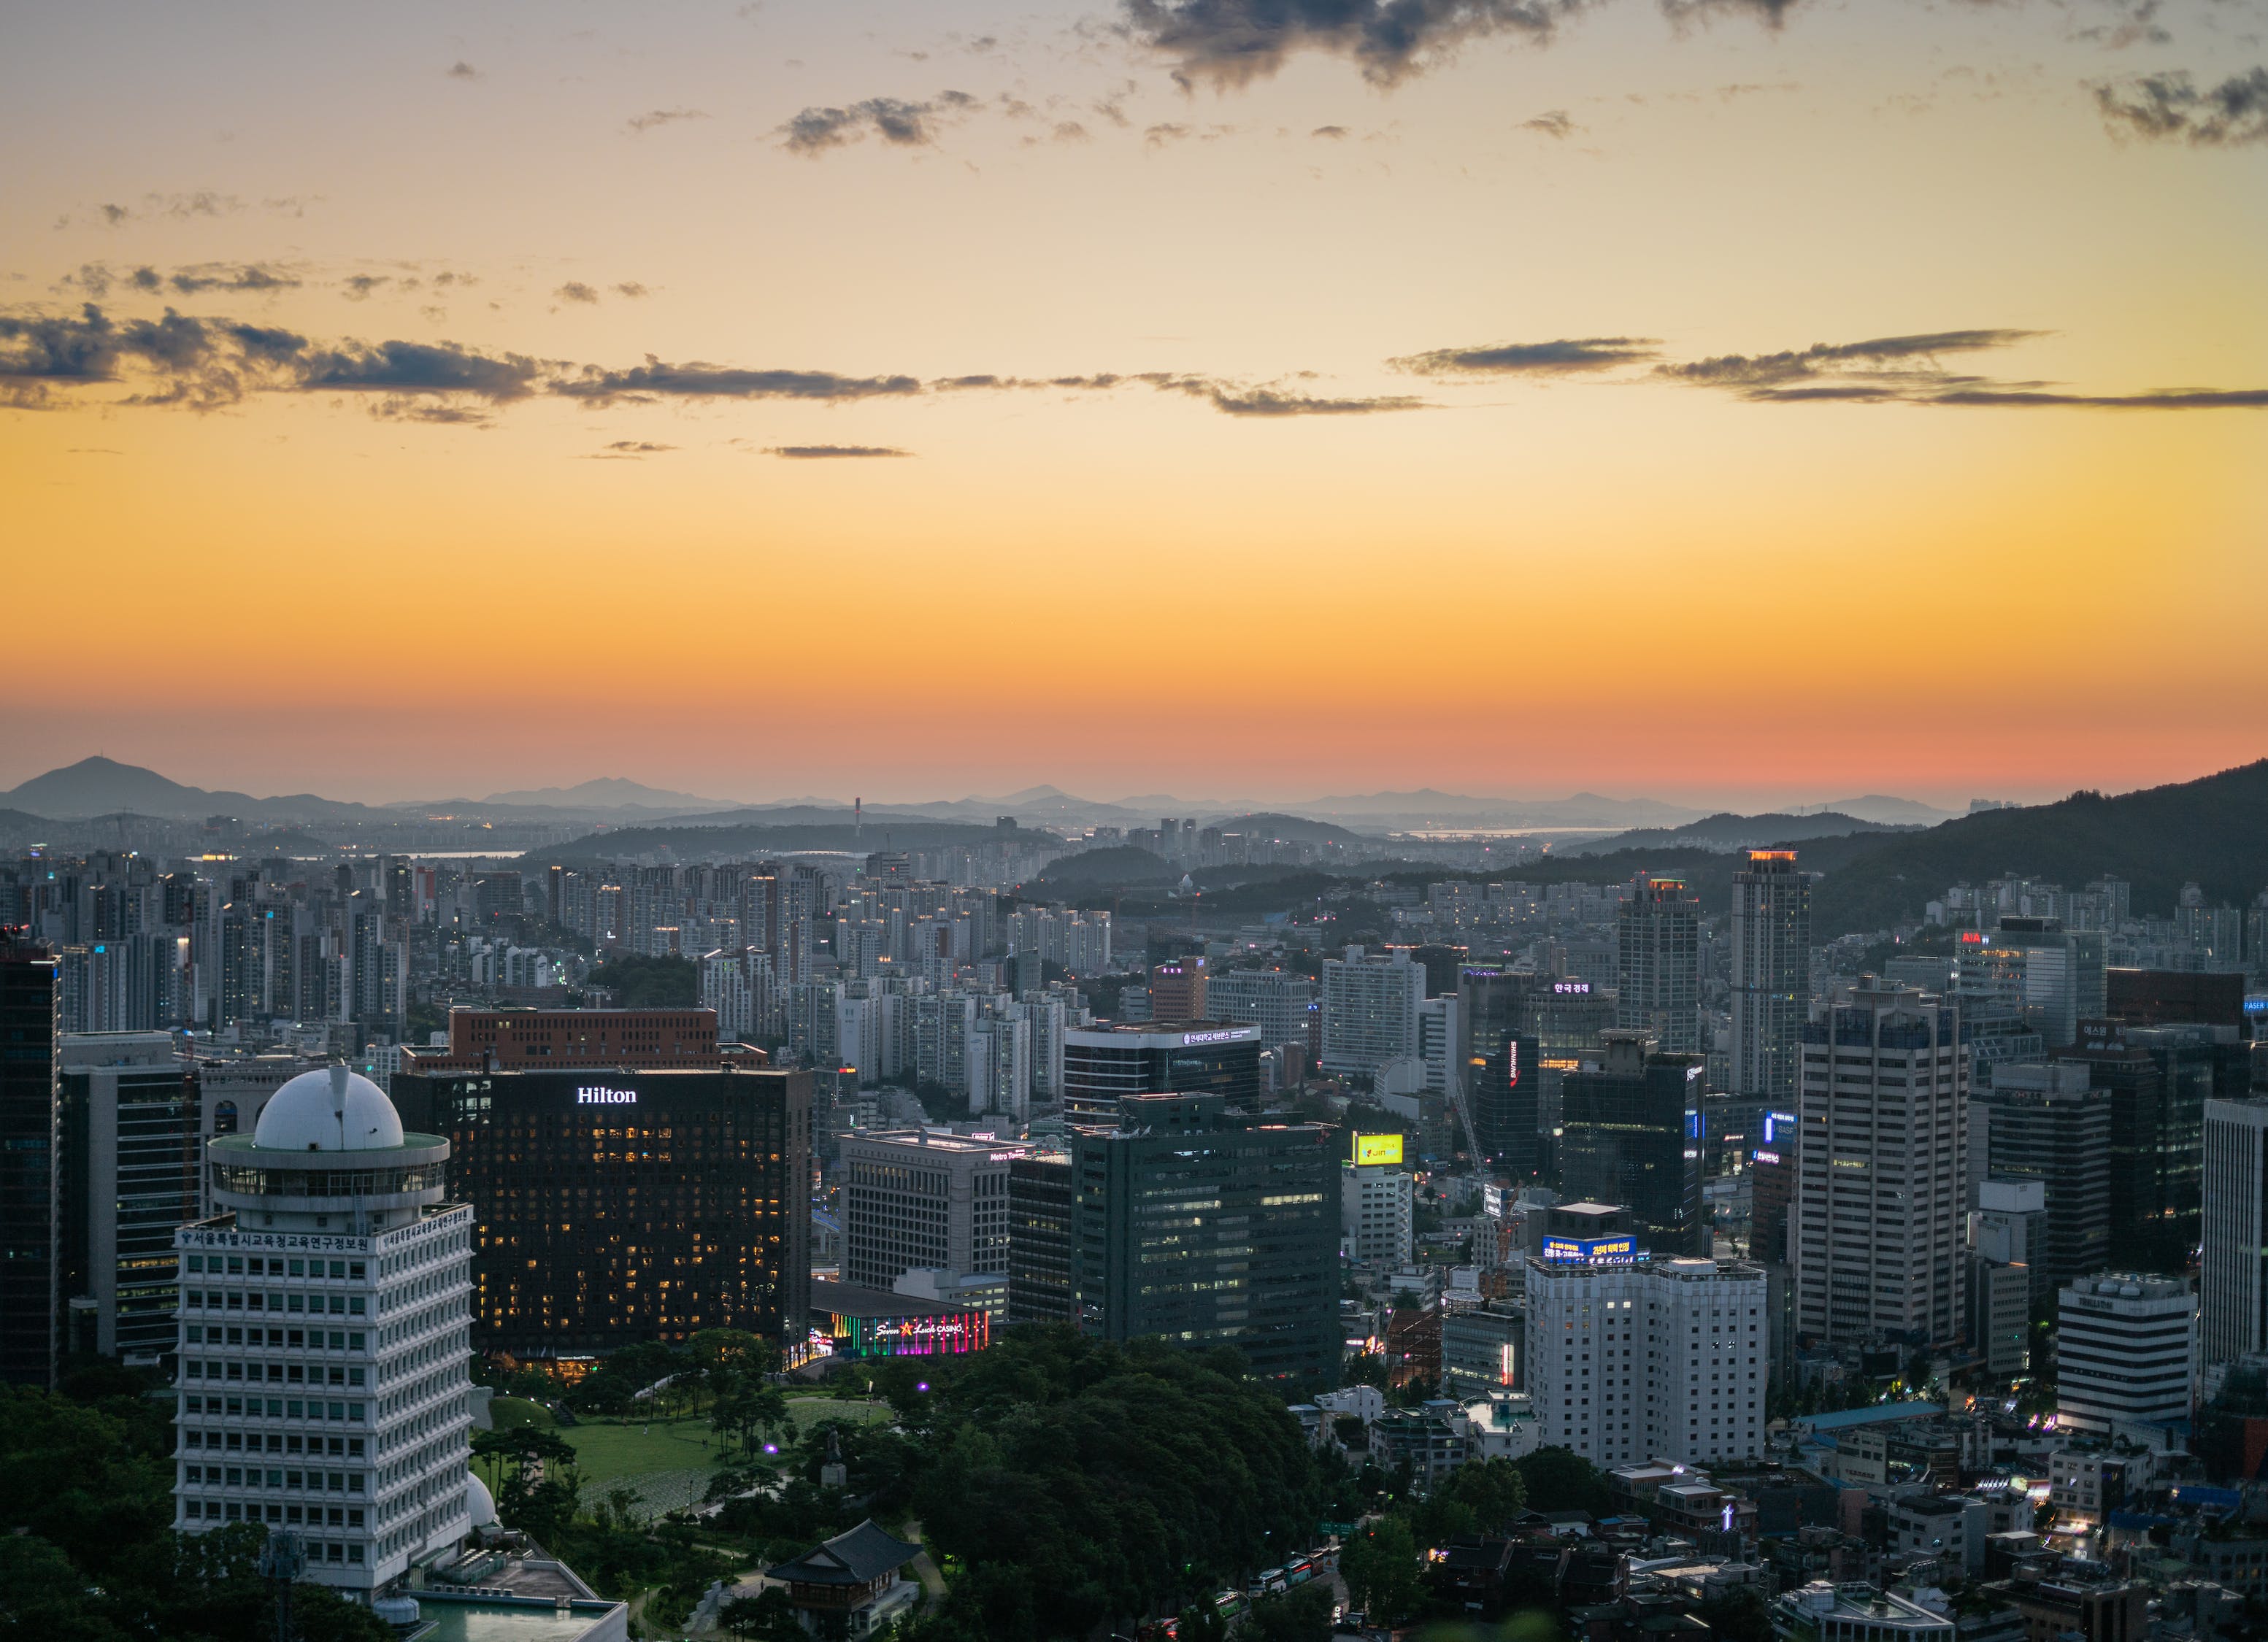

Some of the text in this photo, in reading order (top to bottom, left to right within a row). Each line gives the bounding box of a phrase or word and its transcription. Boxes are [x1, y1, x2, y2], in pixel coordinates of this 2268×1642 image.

[1962, 932, 1980, 942] AIA
[1555, 983, 1588, 992] 한국경제
[577, 1087, 637, 1103] Hilton
[991, 1153, 1007, 1161] Metro
[1619, 1241, 1630, 1252] 인정
[876, 1322, 962, 1336] Seven Luck CASINO
